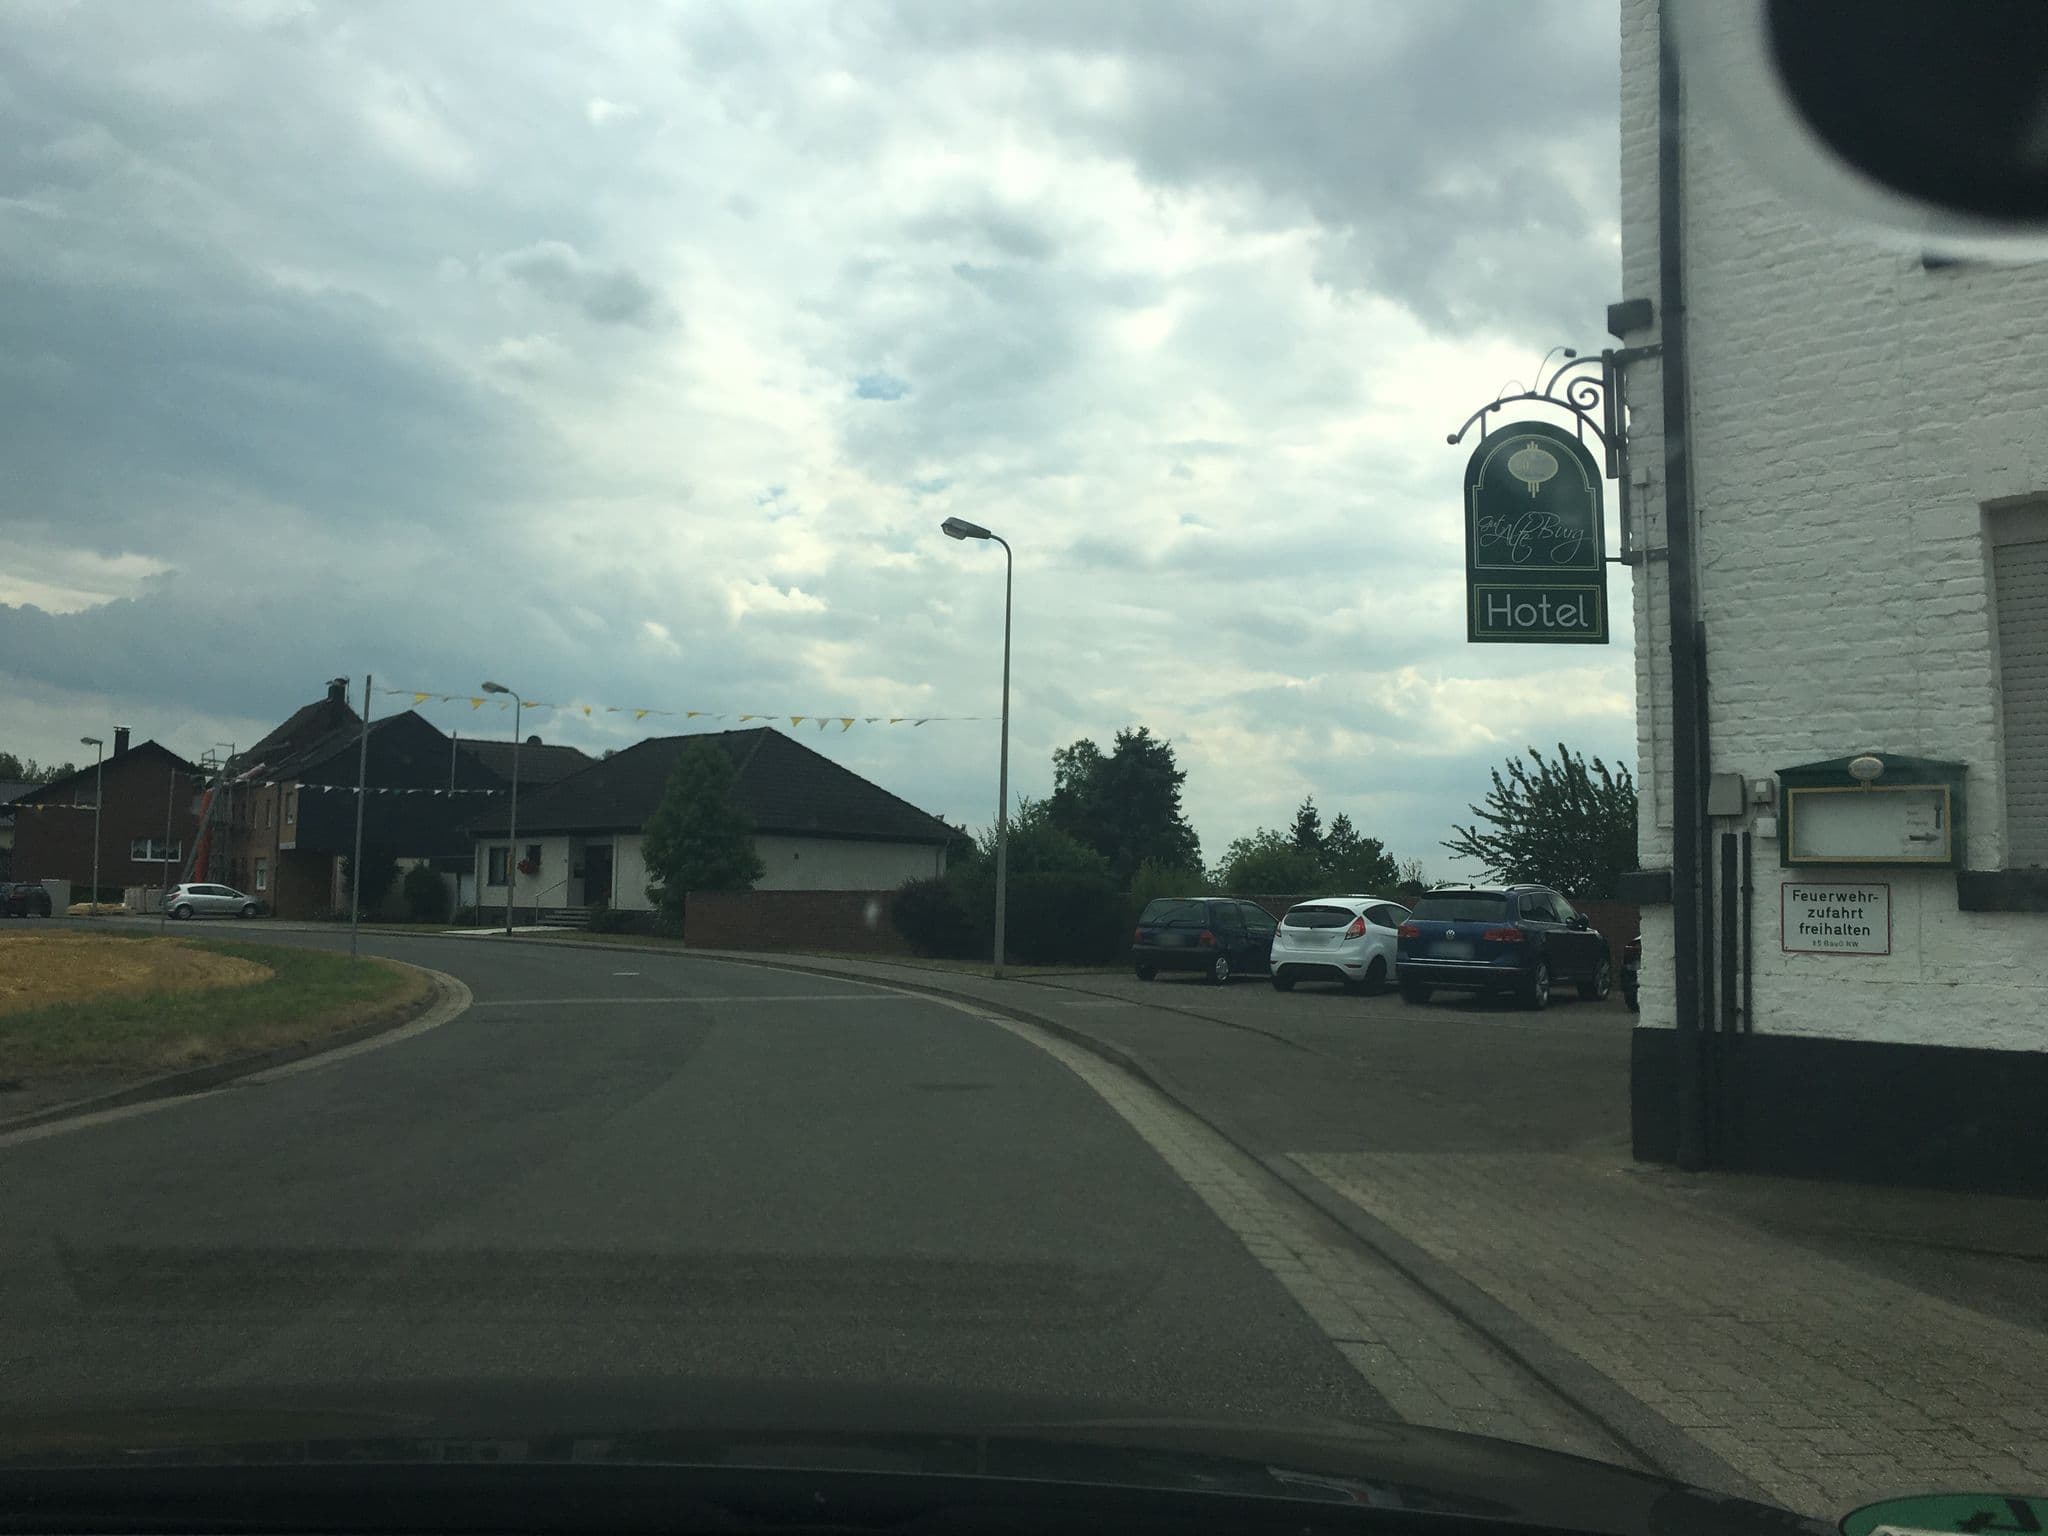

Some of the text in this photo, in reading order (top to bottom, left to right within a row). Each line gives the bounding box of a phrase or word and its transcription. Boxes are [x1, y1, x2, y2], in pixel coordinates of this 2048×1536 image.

[1537, 512, 1591, 564] Burg
[1487, 593, 1589, 627] Hotel
[1792, 889, 1879, 902] Feuerwehr-
[1807, 906, 1864, 919] zufahrt
[1799, 922, 1871, 936] freihalten
